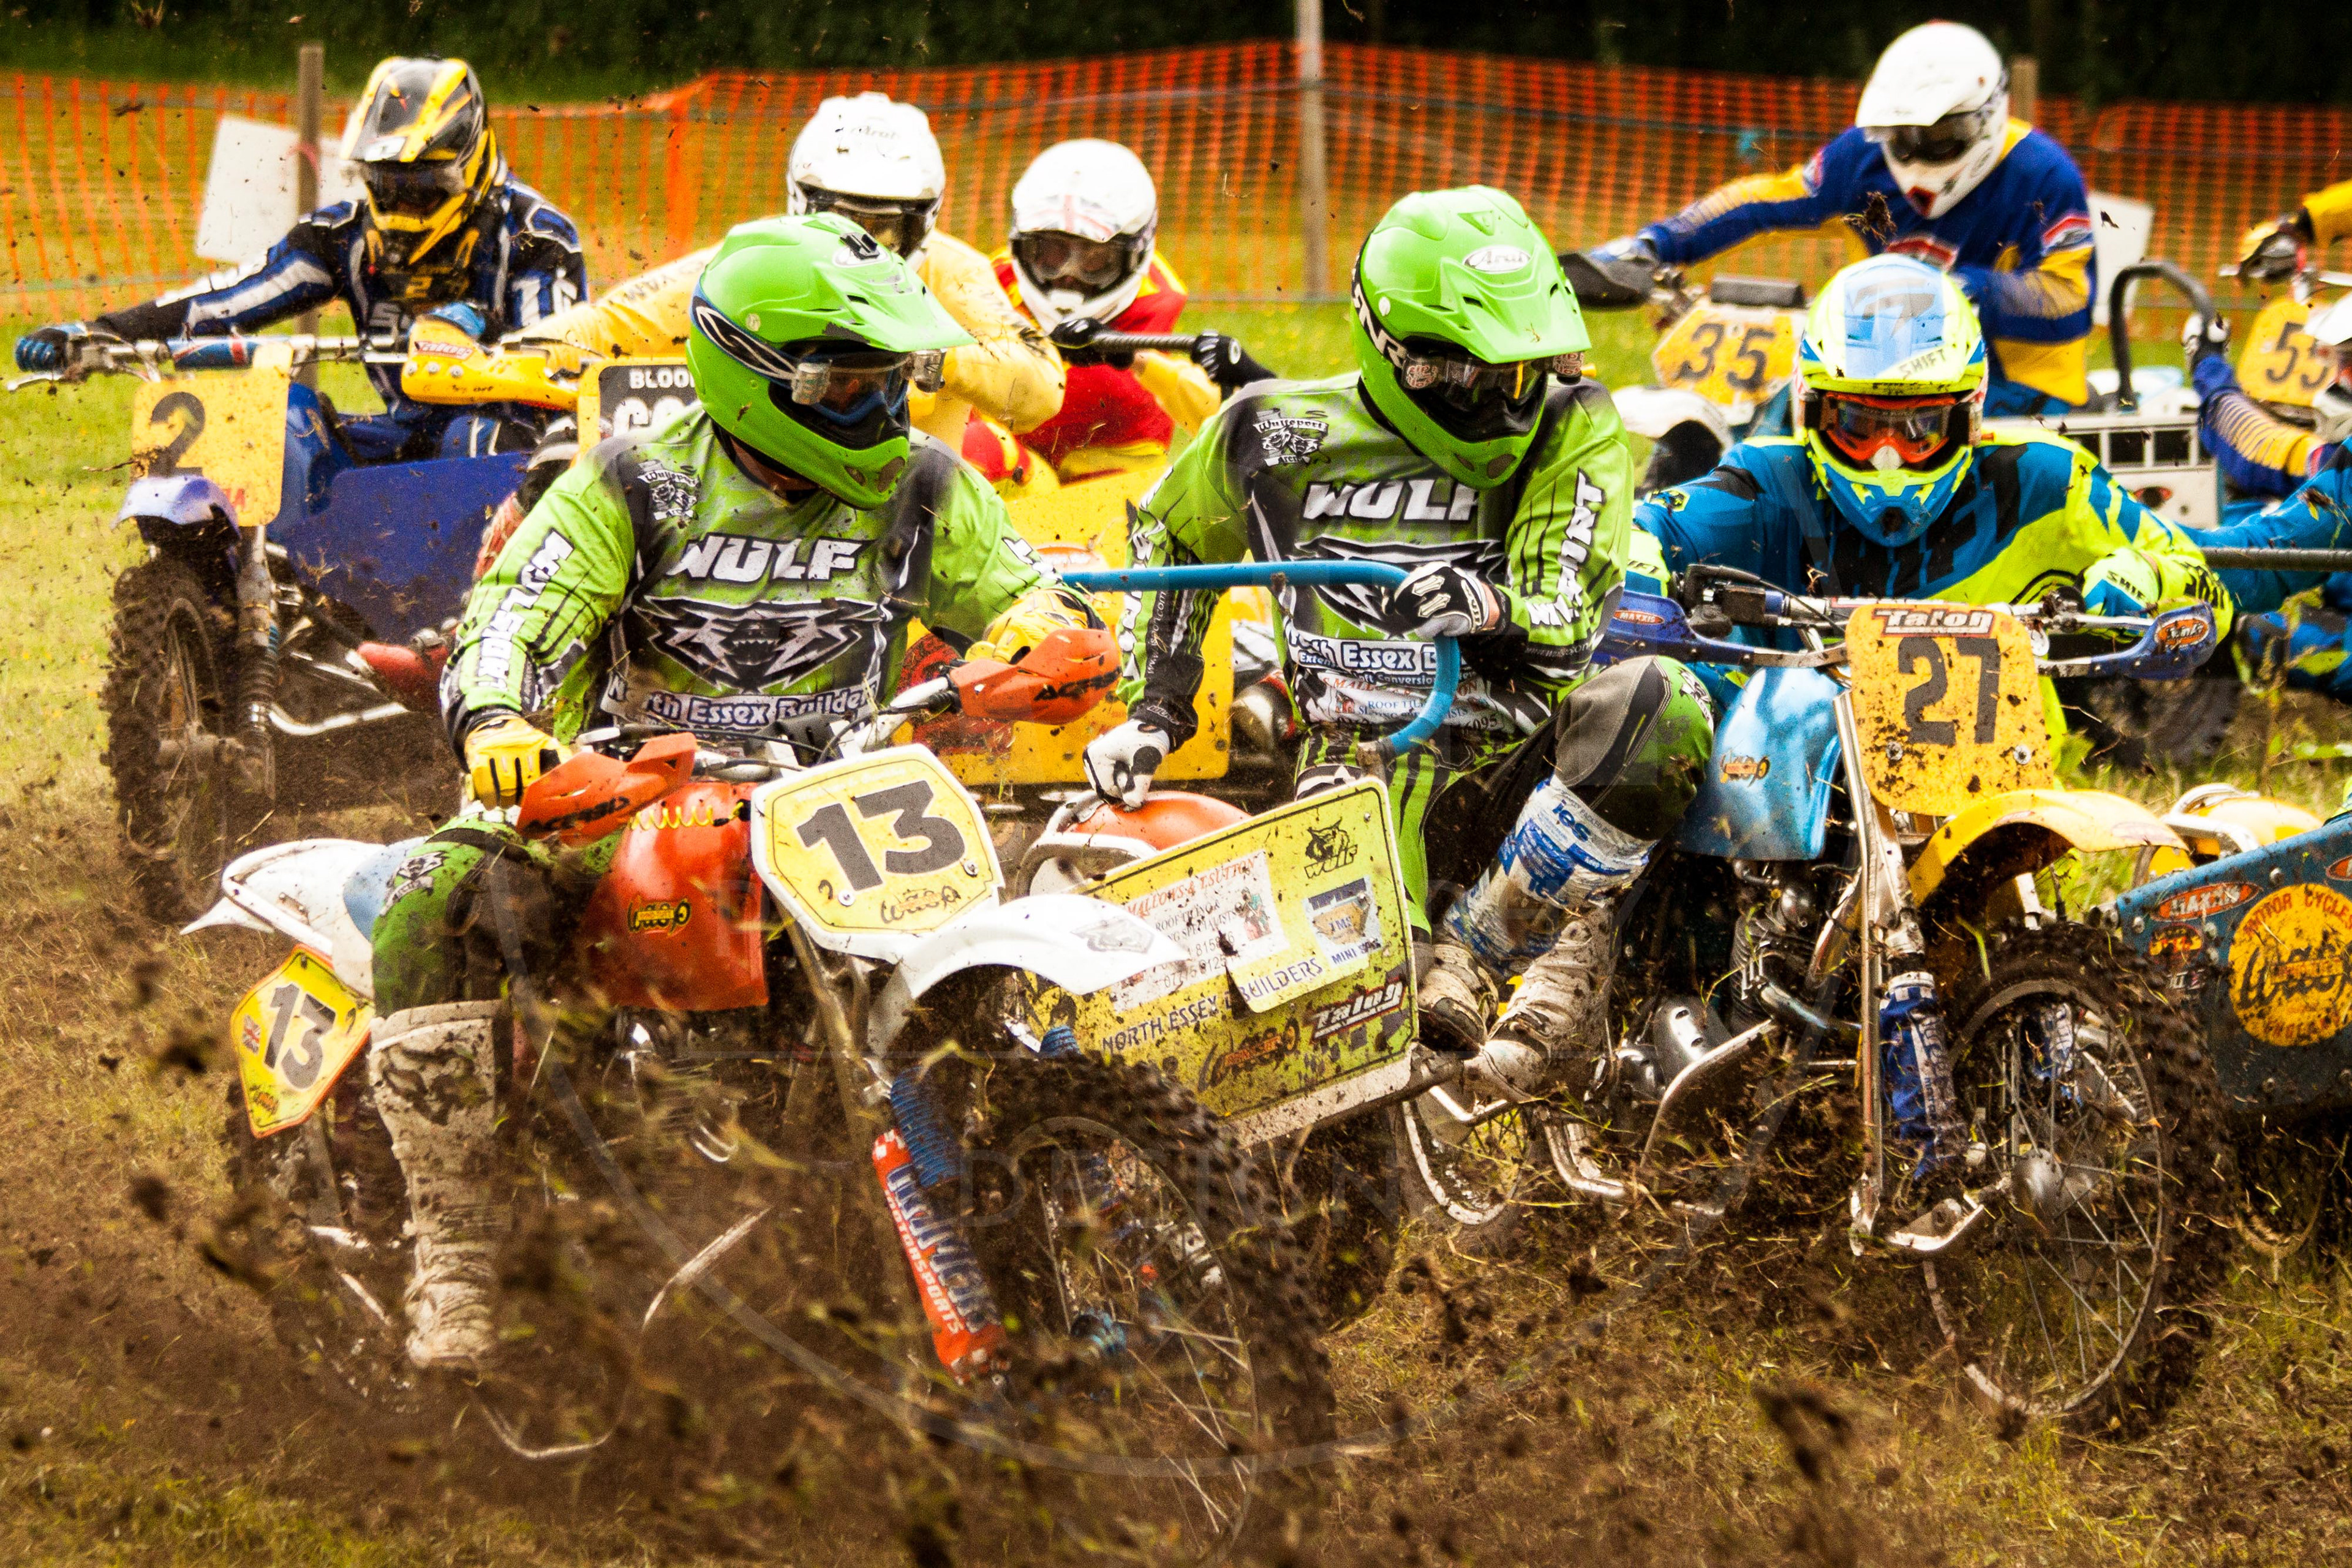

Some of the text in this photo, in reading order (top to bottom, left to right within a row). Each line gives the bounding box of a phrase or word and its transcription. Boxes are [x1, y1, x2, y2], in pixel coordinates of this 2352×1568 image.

[630, 368, 695, 389] BLOO
[1676, 323, 1775, 392] 35
[1899, 349, 1946, 380] SHIFT
[149, 391, 206, 475] 2
[1618, 611, 1657, 624] MAXXIS
[1341, 642, 1415, 671] Essex
[687, 698, 771, 726] Essex
[1898, 637, 2002, 747] 27
[796, 779, 966, 892] 13
[1331, 949, 1358, 963] MINI
[263, 981, 337, 1092] 13
[1102, 1017, 1163, 1052] NORTH
[1169, 994, 1218, 1031] ESSEX
